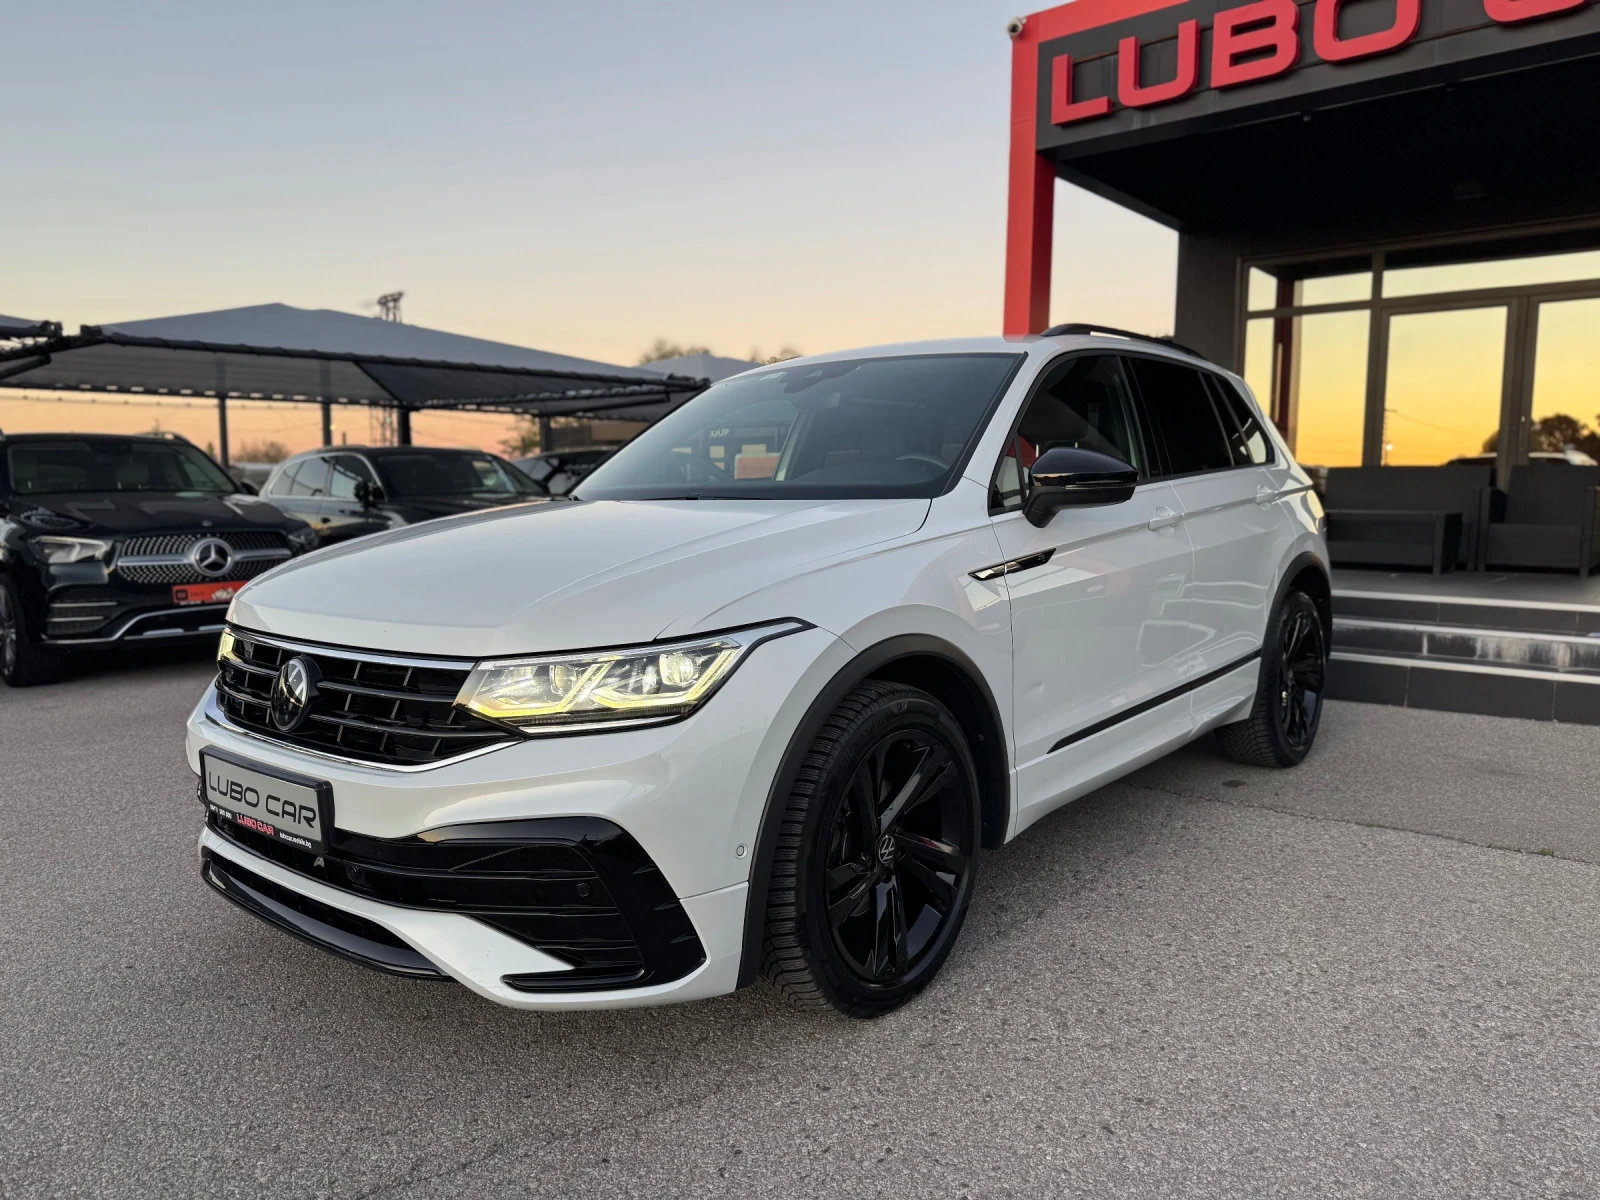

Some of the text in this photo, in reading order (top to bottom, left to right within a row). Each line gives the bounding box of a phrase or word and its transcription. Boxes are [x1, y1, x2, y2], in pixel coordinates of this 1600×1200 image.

[1051, 0, 1420, 126] LUBO
[208, 771, 260, 808] LUBO
[265, 794, 317, 829] CAR
[236, 813, 274, 836] LUBO CAR
